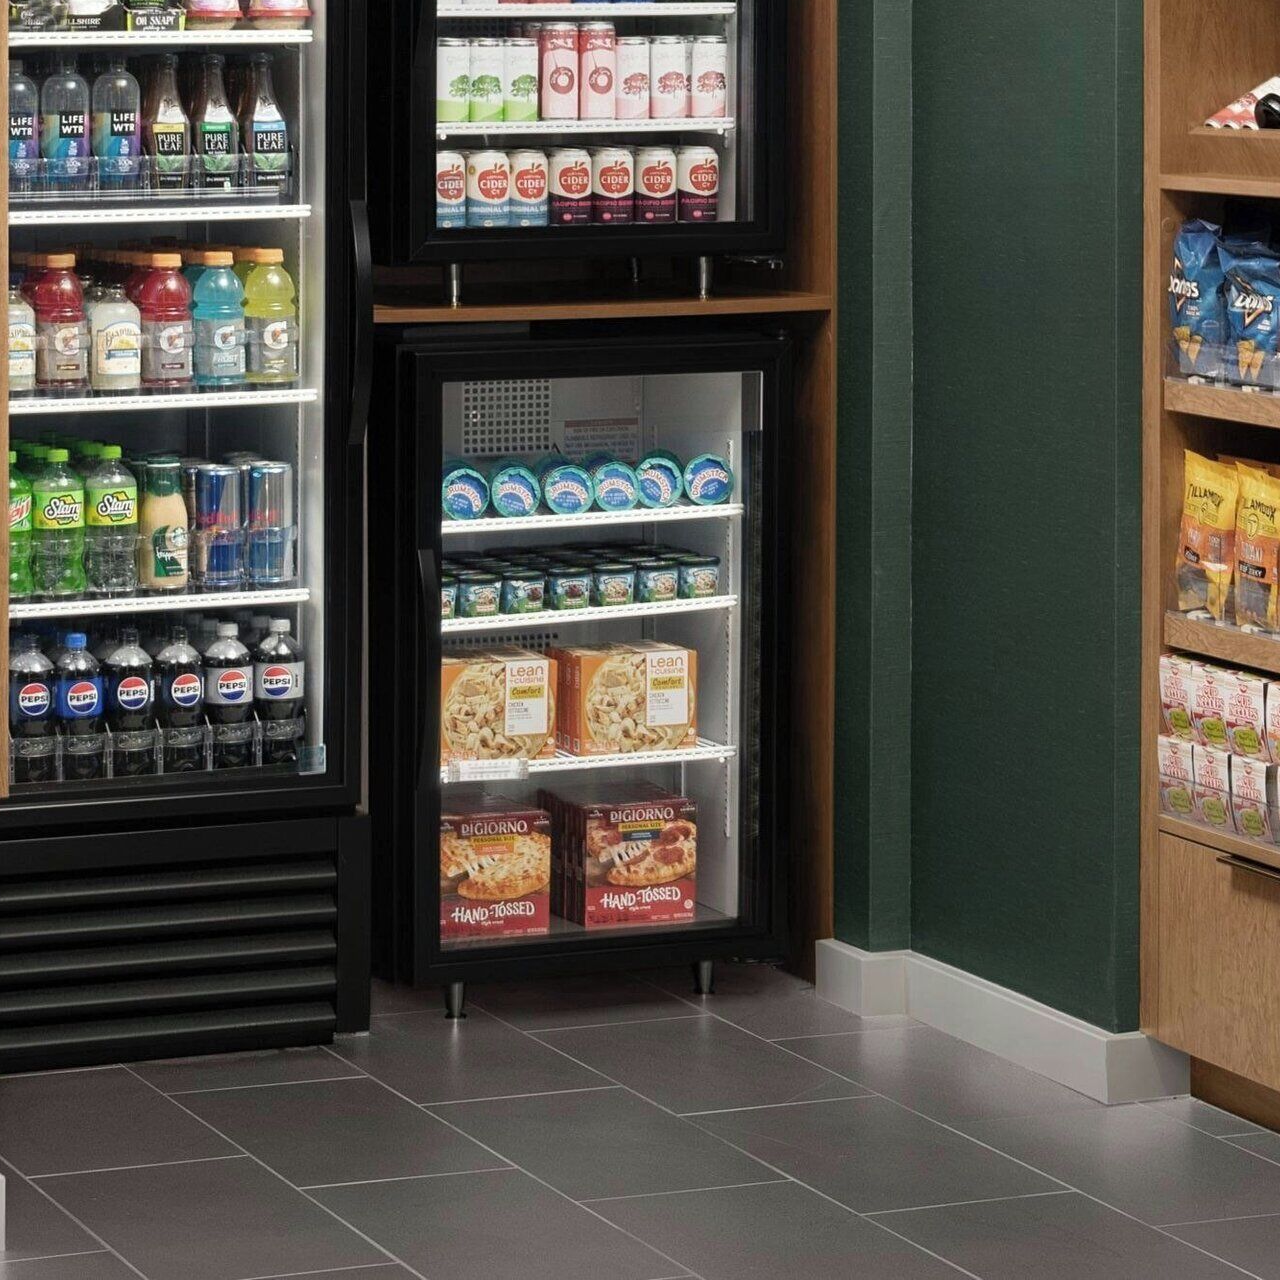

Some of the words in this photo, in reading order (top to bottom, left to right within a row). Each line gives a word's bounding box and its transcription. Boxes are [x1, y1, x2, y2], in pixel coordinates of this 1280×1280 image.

[11, 117, 33, 125] LIFE
[62, 115, 84, 123] LIFE
[113, 113, 135, 121] LIFE
[11, 127, 33, 136] WTR
[62, 125, 84, 133] WTR
[113, 123, 135, 132] WTR
[158, 133, 182, 142] PURE
[205, 133, 228, 141] PURE
[257, 132, 283, 141] PURE
[517, 180, 545, 189] CIDER
[561, 176, 588, 185] CIDER
[601, 176, 629, 184] CIDER
[644, 176, 672, 184] CIDER
[480, 180, 508, 190] CIDER
[650, 656, 684, 668] Lean
[510, 665, 544, 677] Lean
[220, 682, 246, 690] PEPSI
[652, 678, 682, 687] Comfort
[119, 688, 147, 696] PEPSI
[173, 686, 200, 694] PEPSI
[511, 687, 541, 696] Comfort
[21, 695, 49, 703] PEPSI
[69, 694, 97, 702] PEPSI
[610, 807, 674, 823] DIGIORNO
[461, 820, 528, 836] DIGIORNO
[600, 886, 681, 910] HAND-TOSSED
[451, 901, 535, 924] HAND-TOSSED
